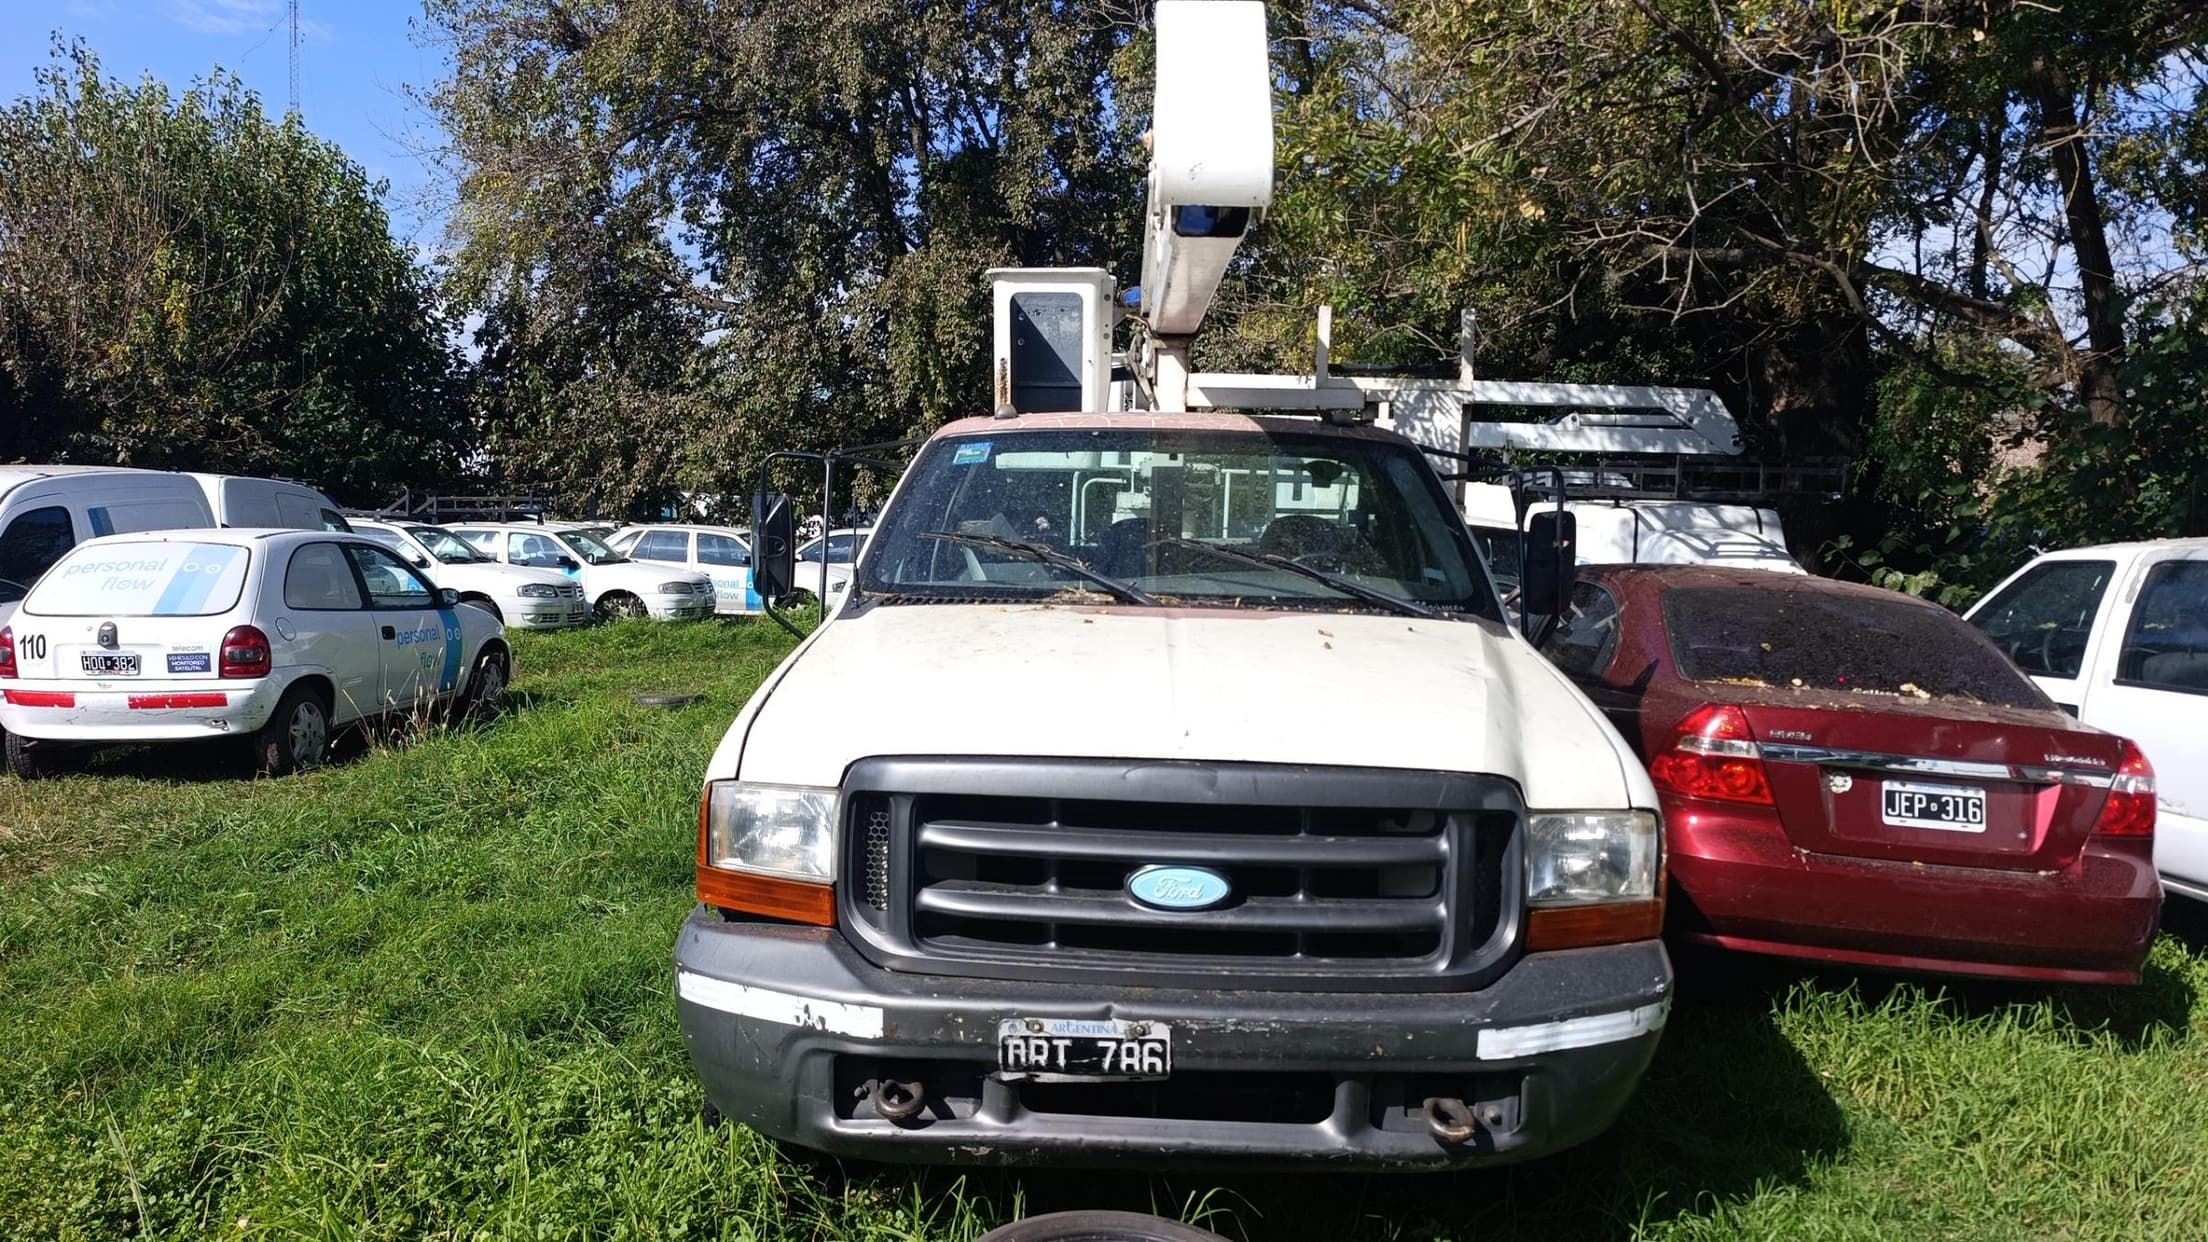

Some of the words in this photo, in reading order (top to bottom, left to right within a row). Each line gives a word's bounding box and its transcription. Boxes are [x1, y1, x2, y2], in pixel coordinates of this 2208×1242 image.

[62, 557, 168, 579] personal
[100, 575, 157, 591] flow
[716, 589, 740, 600] flow
[19, 633, 47, 660] 110
[396, 624, 441, 650] personal
[112, 656, 136, 671] 382
[1887, 791, 1926, 818] JEP
[1941, 796, 1981, 823] 316
[1154, 877, 1204, 900] Ford
[1051, 1021, 1120, 1036] ARGENTINA
